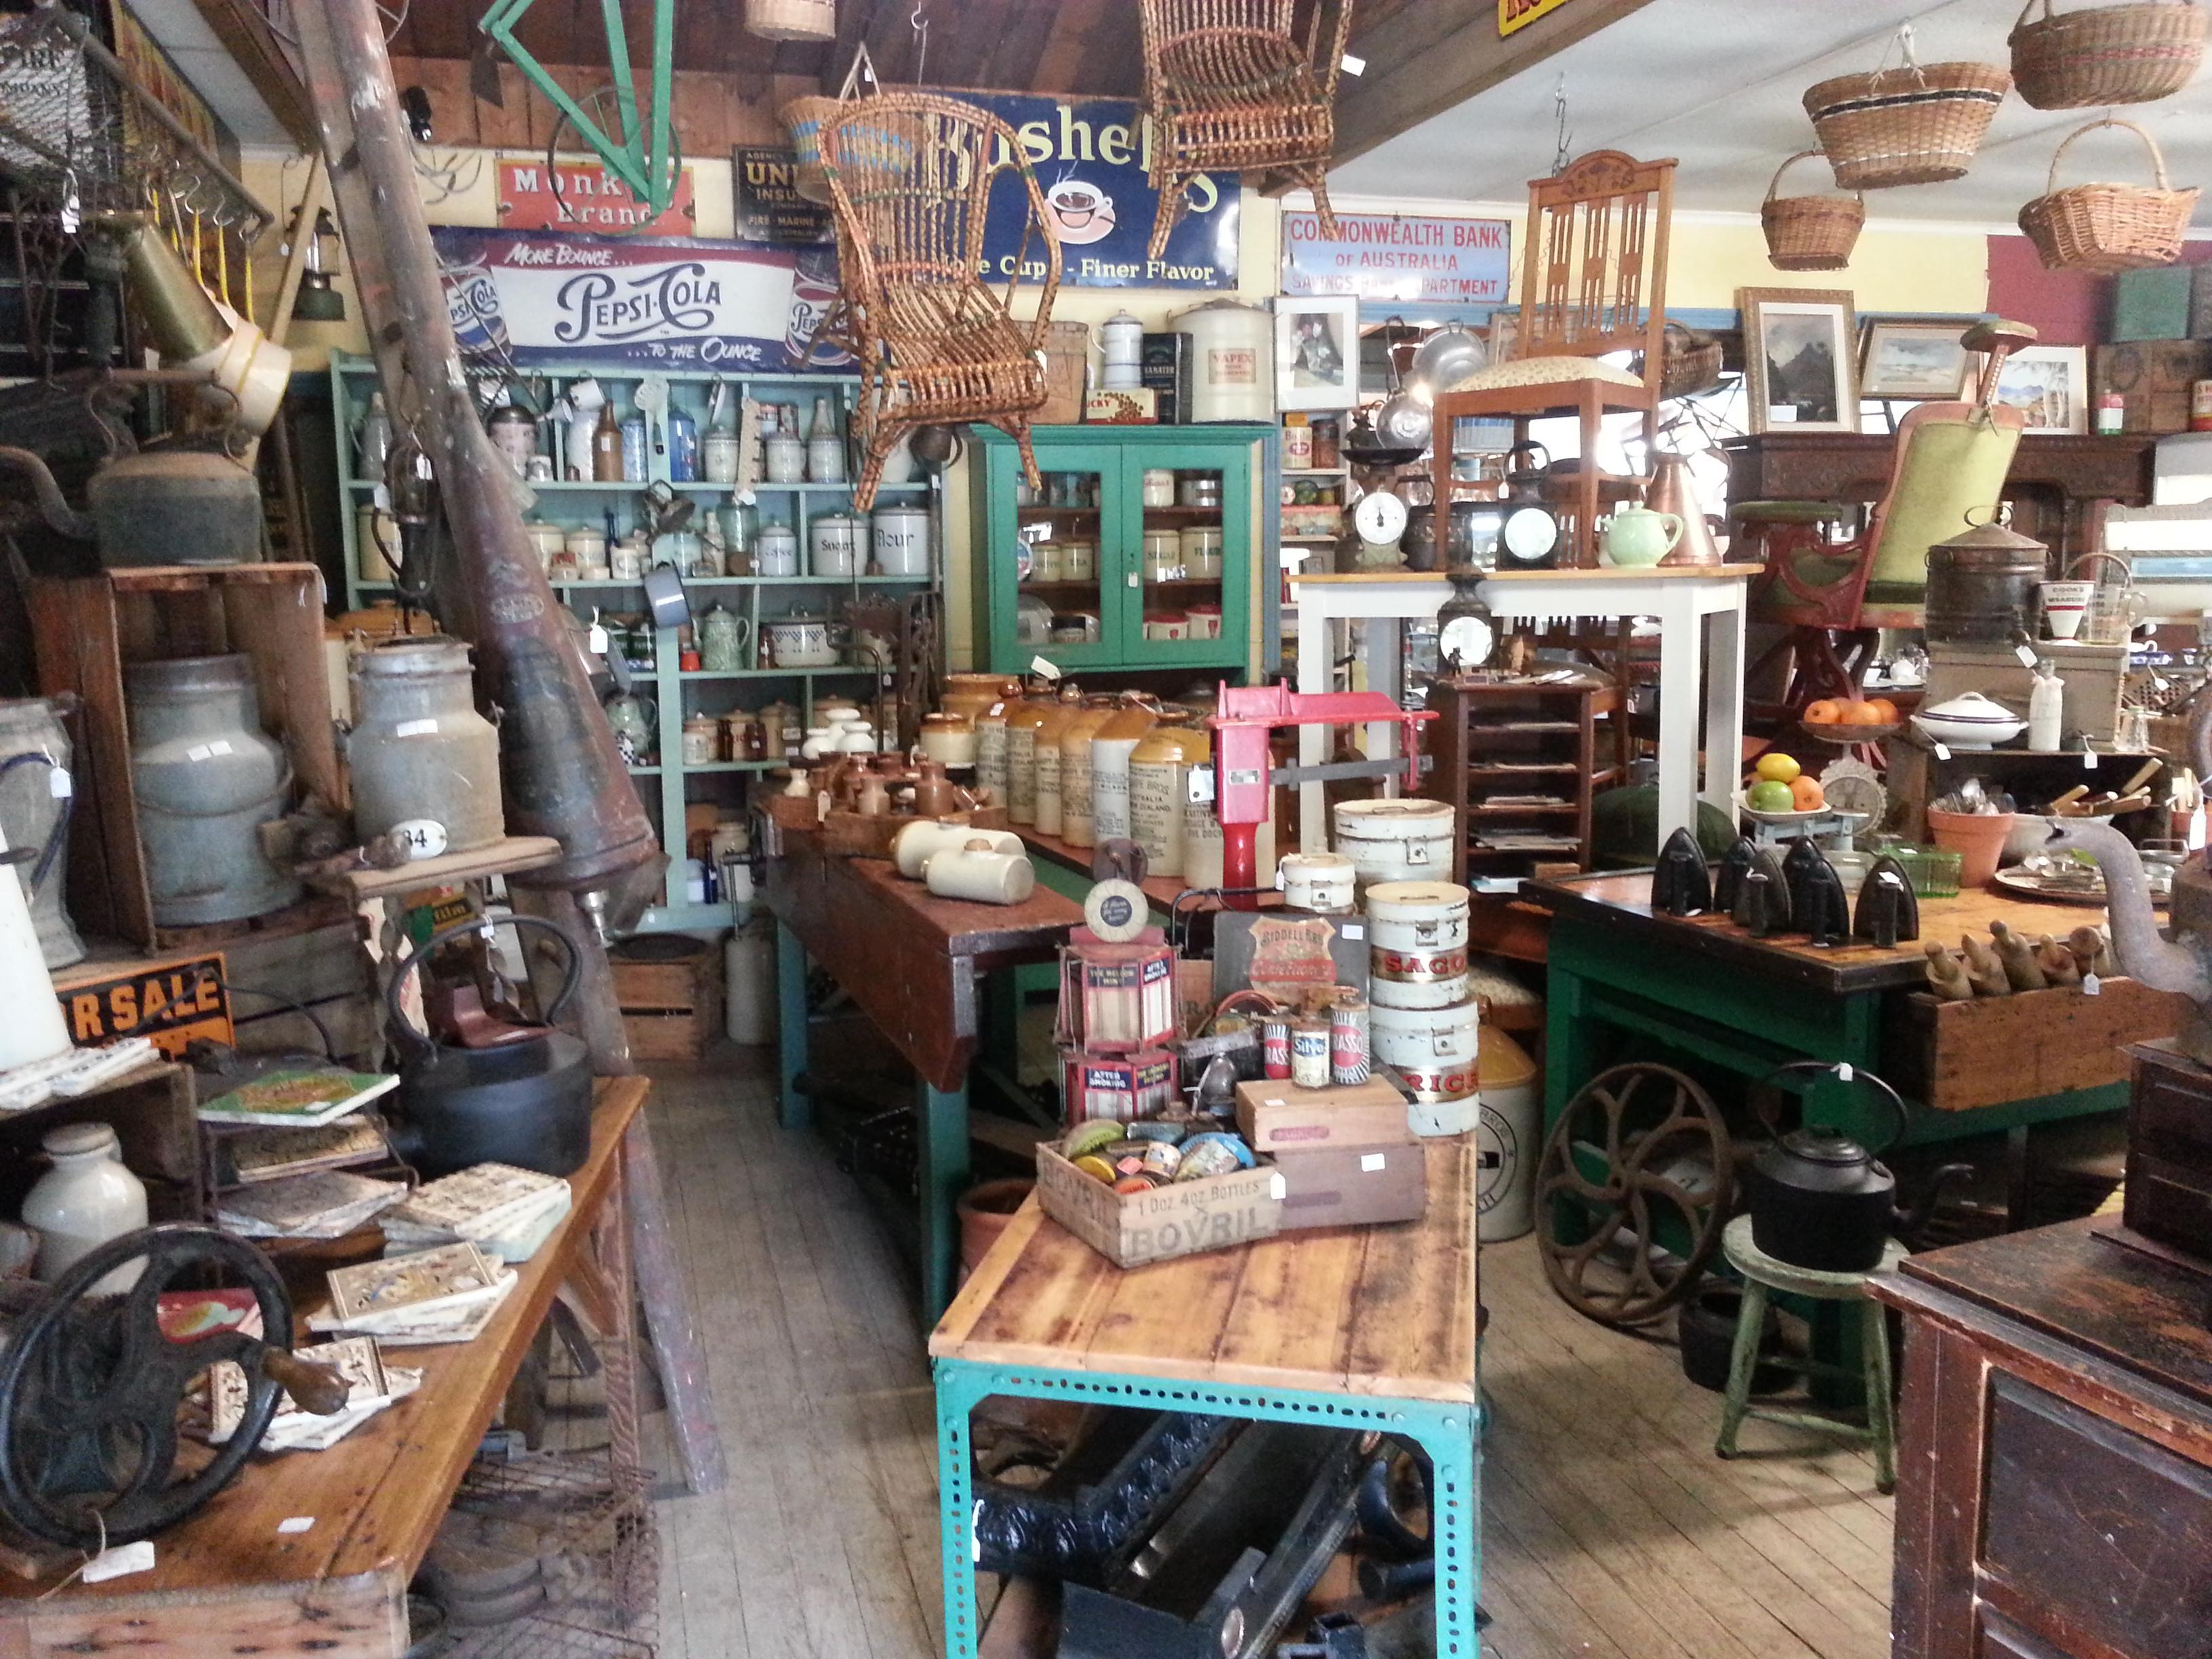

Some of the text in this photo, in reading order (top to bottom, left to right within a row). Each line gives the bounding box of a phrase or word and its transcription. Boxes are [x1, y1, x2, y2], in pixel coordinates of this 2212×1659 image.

[514, 169, 674, 209] Monk
[1454, 224, 1502, 249] BANK
[1082, 259, 1140, 278] Finer
[1147, 261, 1214, 281] Flavor
[1336, 251, 1459, 271] OF AUSTRALIA
[1413, 277, 1498, 295] PARTMENT
[670, 343, 696, 359] THE
[701, 337, 762, 363] OUNCE
[1087, 399, 1111, 407] CKY
[1130, 795, 1163, 803] STRALIA
[1385, 956, 1466, 974] SAGO
[110, 972, 220, 1031] SALE
[1332, 1034, 1364, 1054] RASSO
[1094, 1071, 1121, 1080] AFTER
[1400, 1071, 1479, 1092] RICE
[1211, 1180, 1260, 1200] BOTTLES
[1130, 1206, 1269, 1258] BOVRIL
